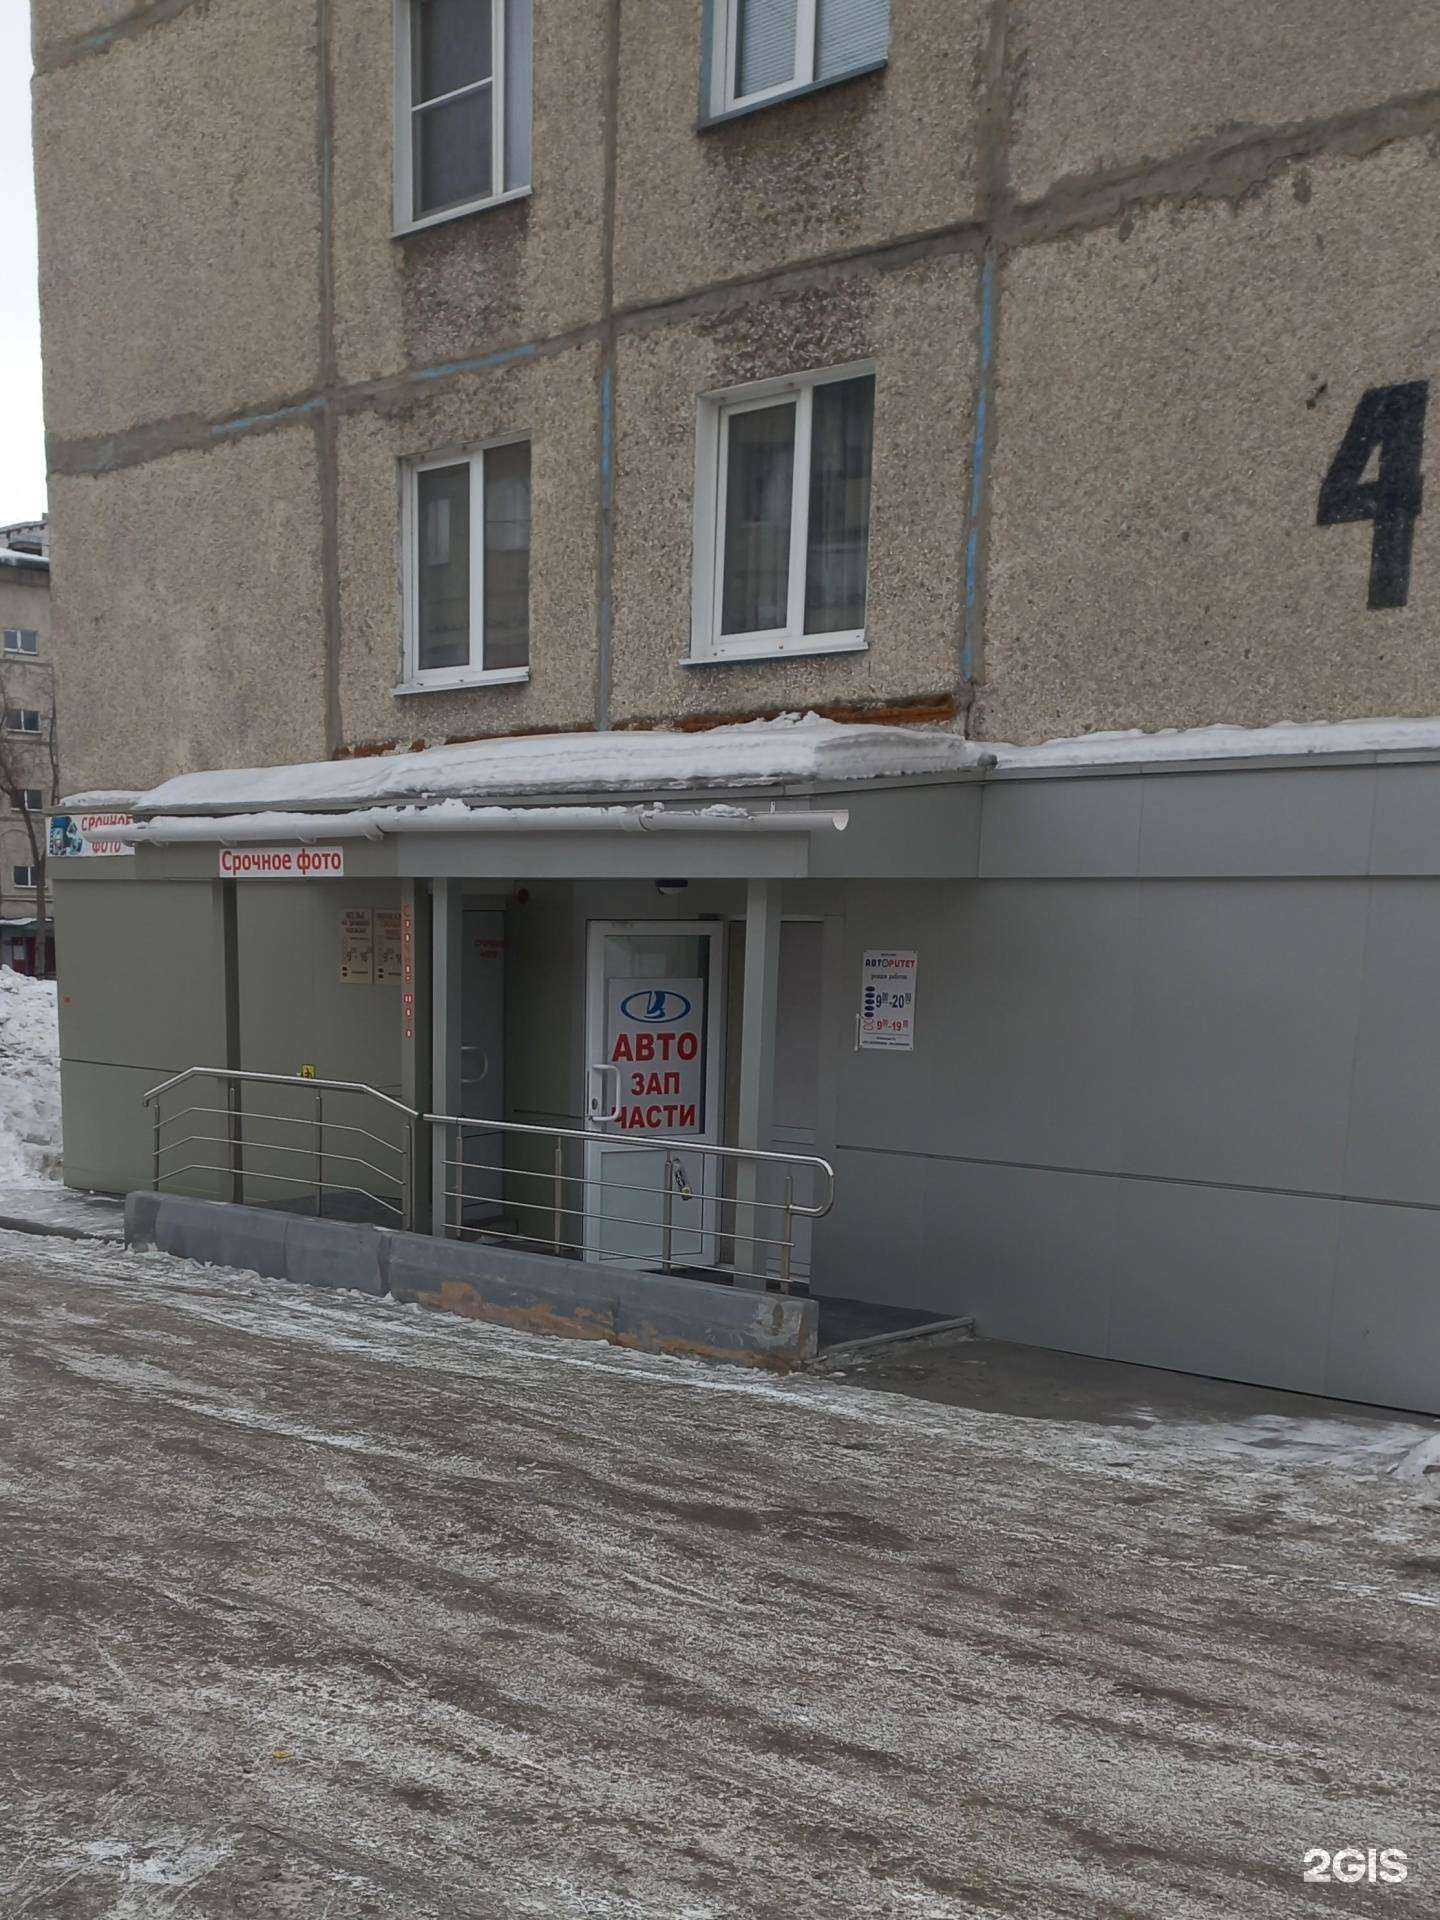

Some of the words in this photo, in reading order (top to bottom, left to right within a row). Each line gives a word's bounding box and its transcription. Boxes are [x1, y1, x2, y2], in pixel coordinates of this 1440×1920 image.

[1317, 380, 1428, 609] 4
[222, 850, 292, 876] Срочное
[297, 848, 341, 875] фото
[612, 1032, 697, 1062] АВТО
[631, 1072, 680, 1096] ЗАП
[612, 1104, 696, 1129] ЧАСТИ
